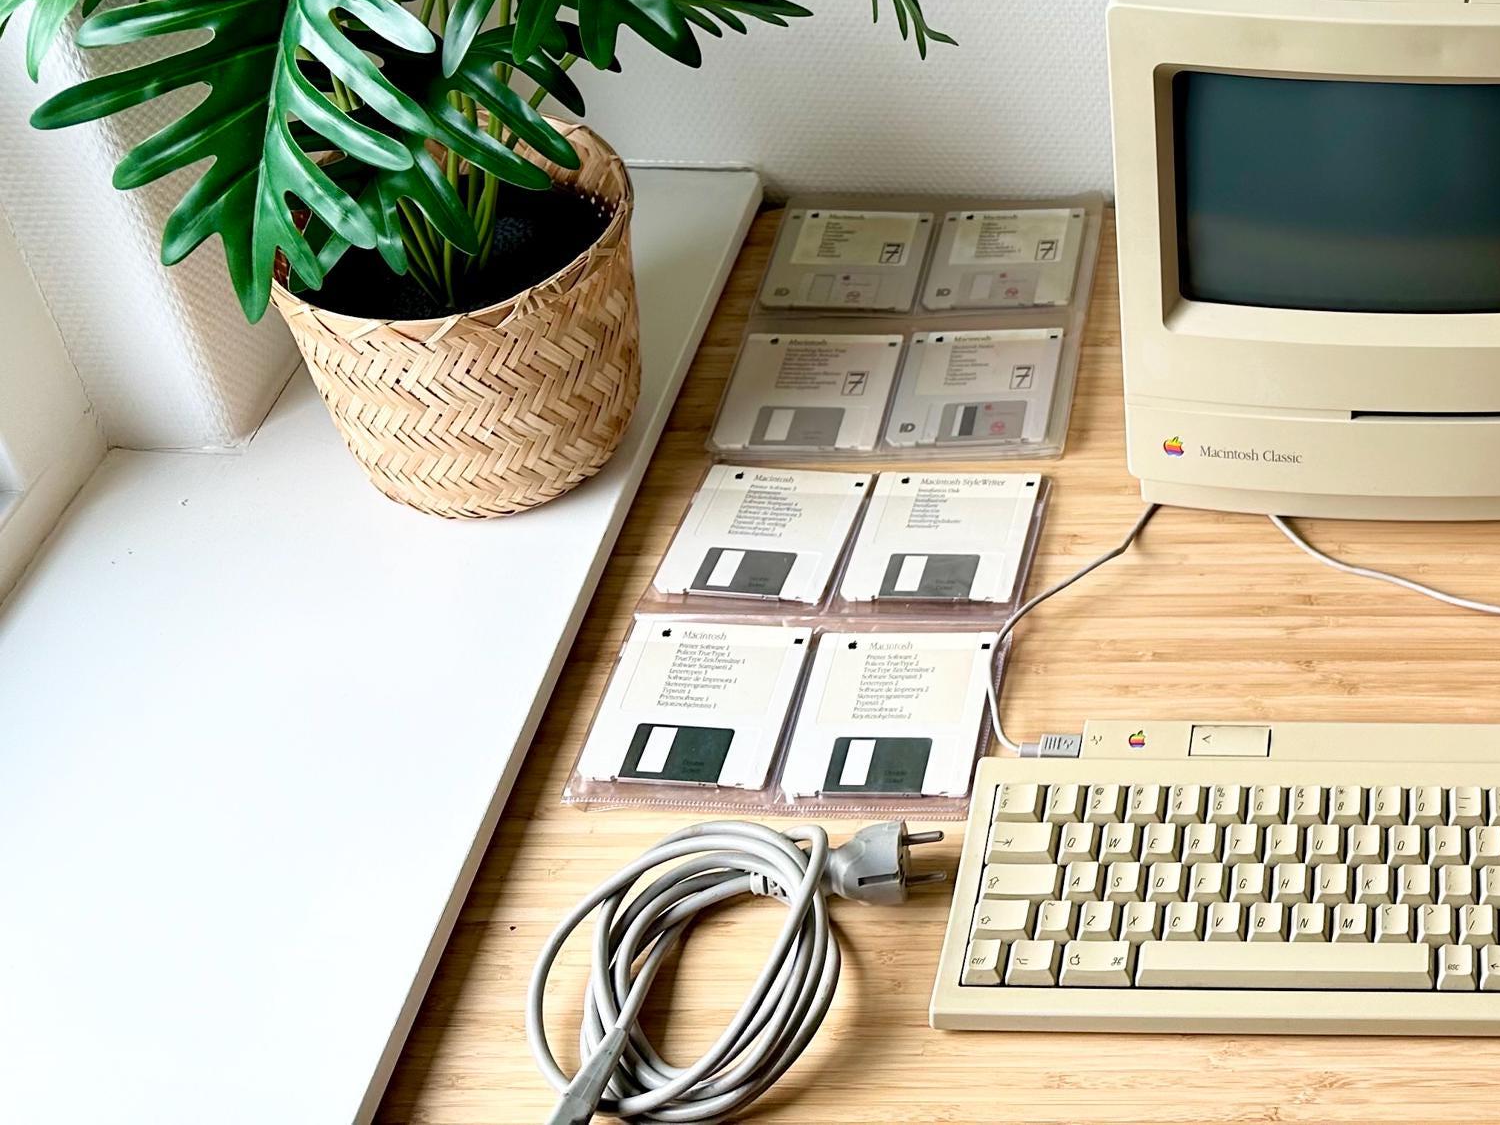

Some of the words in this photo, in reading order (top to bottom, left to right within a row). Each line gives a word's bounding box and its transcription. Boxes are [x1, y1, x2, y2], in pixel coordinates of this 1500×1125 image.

[885, 243, 901, 263] 7
[1040, 240, 1055, 260] 7
[848, 372, 865, 394] 7
[1015, 366, 1031, 387] 7
[1200, 445, 1259, 461] Macintosh
[1263, 451, 1303, 464] Classic
[682, 631, 727, 641] Macintosh
[869, 641, 913, 650] Macintosh
[1092, 799, 1101, 810] 2
[1133, 800, 1142, 810] 3
[1174, 800, 1183, 811] 4
[1215, 800, 1223, 811] 5
[1256, 801, 1264, 811] 6
[1297, 801, 1305, 811] 7
[1337, 801, 1345, 811] 8
[1377, 801, 1385, 812] 9
[1417, 802, 1425, 812] 0
[1108, 837, 1121, 849] W
[1149, 838, 1158, 849] E
[1190, 838, 1200, 849] R
[1233, 838, 1241, 850] T
[1273, 839, 1282, 850] Y
[1315, 839, 1324, 851] U
[1396, 840, 1405, 851] O
[1437, 840, 1448, 851] P
[1071, 876, 1081, 887] A
[1113, 876, 1123, 888] S
[1155, 877, 1165, 888] D
[1197, 877, 1206, 888] F
[1239, 878, 1248, 889] G
[1280, 878, 1290, 889] H
[1322, 879, 1331, 889] J
[1364, 879, 1373, 889] K
[1406, 879, 1414, 890] L
[1086, 915, 1096, 926] Z
[1128, 916, 1139, 927] X
[1171, 916, 1181, 928] C
[1215, 917, 1224, 928] V
[1256, 916, 1266, 928] B
[1299, 918, 1309, 929] N
[1342, 918, 1354, 929] M
[970, 955, 987, 966] ctrl
[1446, 962, 1461, 971] esc
